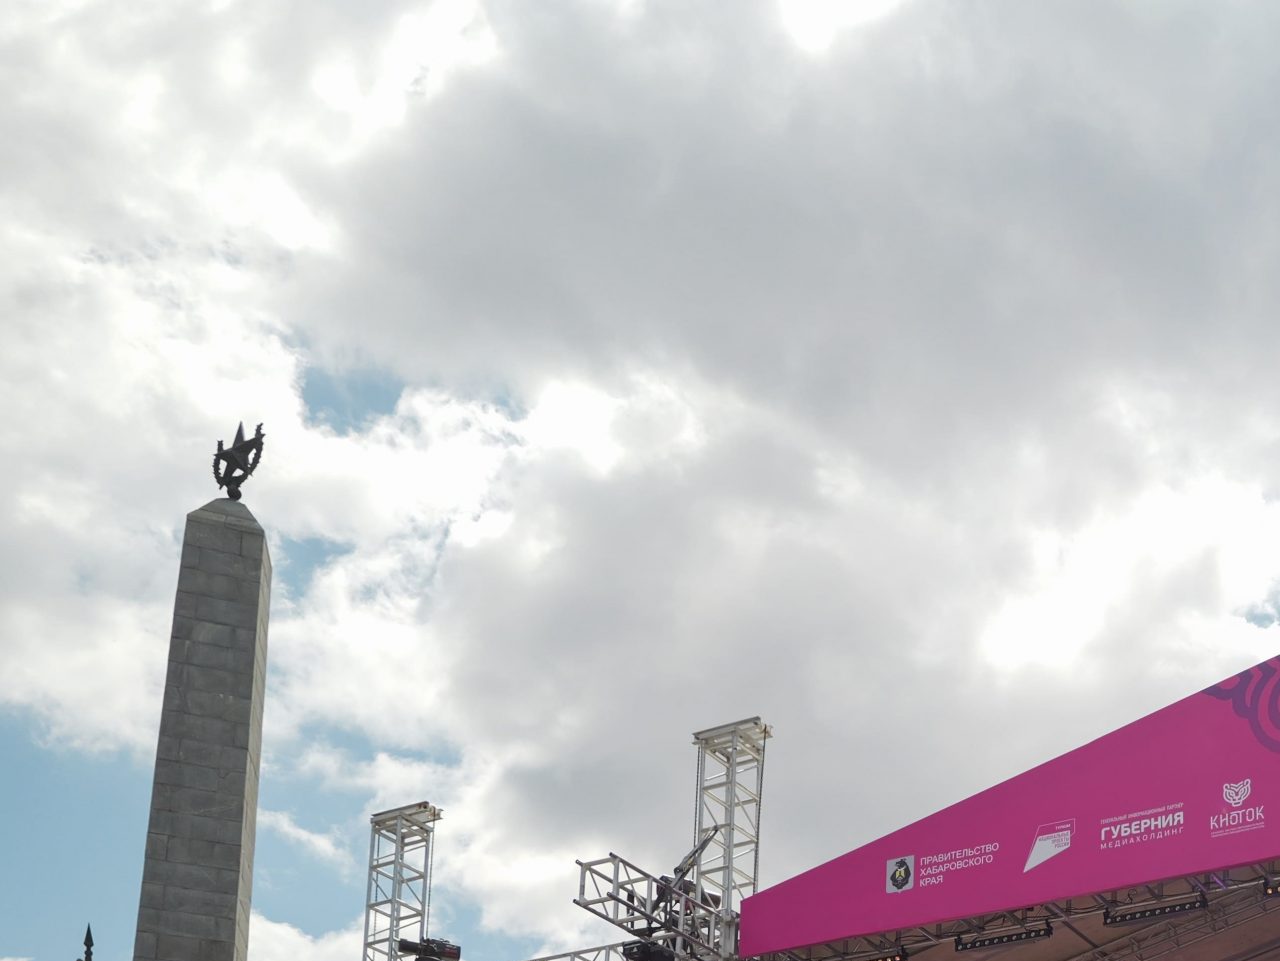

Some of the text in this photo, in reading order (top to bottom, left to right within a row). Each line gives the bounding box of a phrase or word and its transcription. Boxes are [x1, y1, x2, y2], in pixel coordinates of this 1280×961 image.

[1100, 826, 1184, 850] МЕДИАХОЛДИНГ
[1101, 811, 1184, 841] ГУБЕРНИЯ
[919, 854, 993, 877] ХАБАРОВСКОГО
[920, 842, 999, 866] ПРАВИТЕЛЬСТВО
[919, 875, 943, 887] КРАЯ
